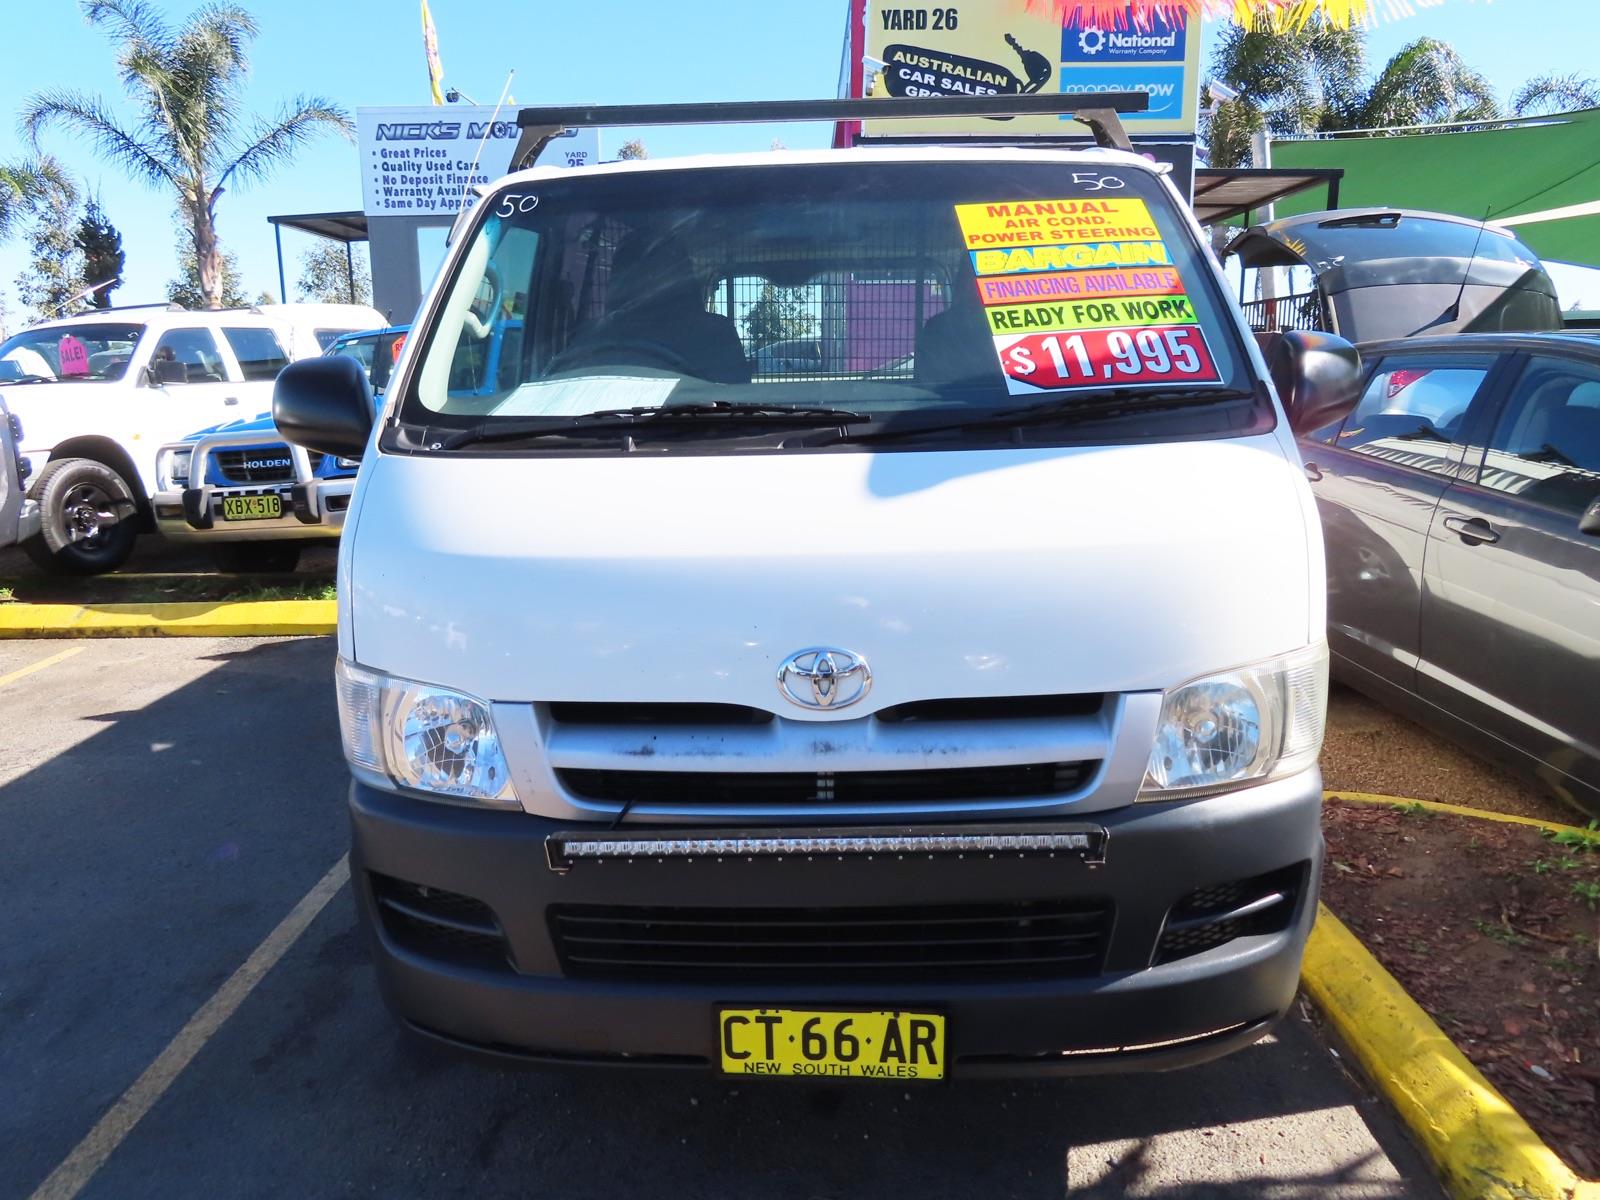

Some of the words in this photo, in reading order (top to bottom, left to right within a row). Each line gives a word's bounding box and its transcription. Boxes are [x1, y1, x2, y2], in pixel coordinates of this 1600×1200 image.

[881, 9, 928, 31] YARD
[932, 7, 958, 31] 26
[1108, 31, 1176, 47] National
[1108, 48, 1137, 56] Warranty
[1139, 47, 1168, 56] Company
[893, 51, 1008, 87] AUSTRALIAN
[899, 68, 936, 87] CAR
[940, 78, 998, 96] SALES
[376, 121, 461, 141] NICK'S
[380, 148, 410, 159] Great
[414, 147, 447, 158] Prices
[382, 161, 422, 174] Quality
[426, 160, 453, 172] Used
[456, 160, 480, 171] Cars
[383, 175, 397, 185] No
[401, 173, 443, 187] Deposit
[447, 173, 489, 184] Finance
[1072, 172, 1125, 191] 50
[383, 187, 433, 199] Warranty
[384, 198, 413, 209] Same
[416, 198, 437, 211] Day
[496, 194, 539, 217] 50
[986, 201, 1119, 218] MANUAL
[1004, 217, 1041, 229] AIR
[1043, 215, 1112, 227] COND.
[969, 230, 1043, 245] POWER
[1049, 226, 1156, 240] STEERING
[976, 241, 1168, 274] BARGAIN
[984, 276, 1081, 299] FINANCING
[1085, 271, 1178, 293] AVAILABLE
[992, 306, 1065, 330] READY
[1072, 302, 1120, 324] FOR
[1126, 299, 1193, 321] WORK
[243, 459, 291, 469] HOLDEN
[744, 1062, 782, 1074] NEW
[792, 1063, 851, 1076] SOUTH
[861, 1064, 919, 1078] WALES
